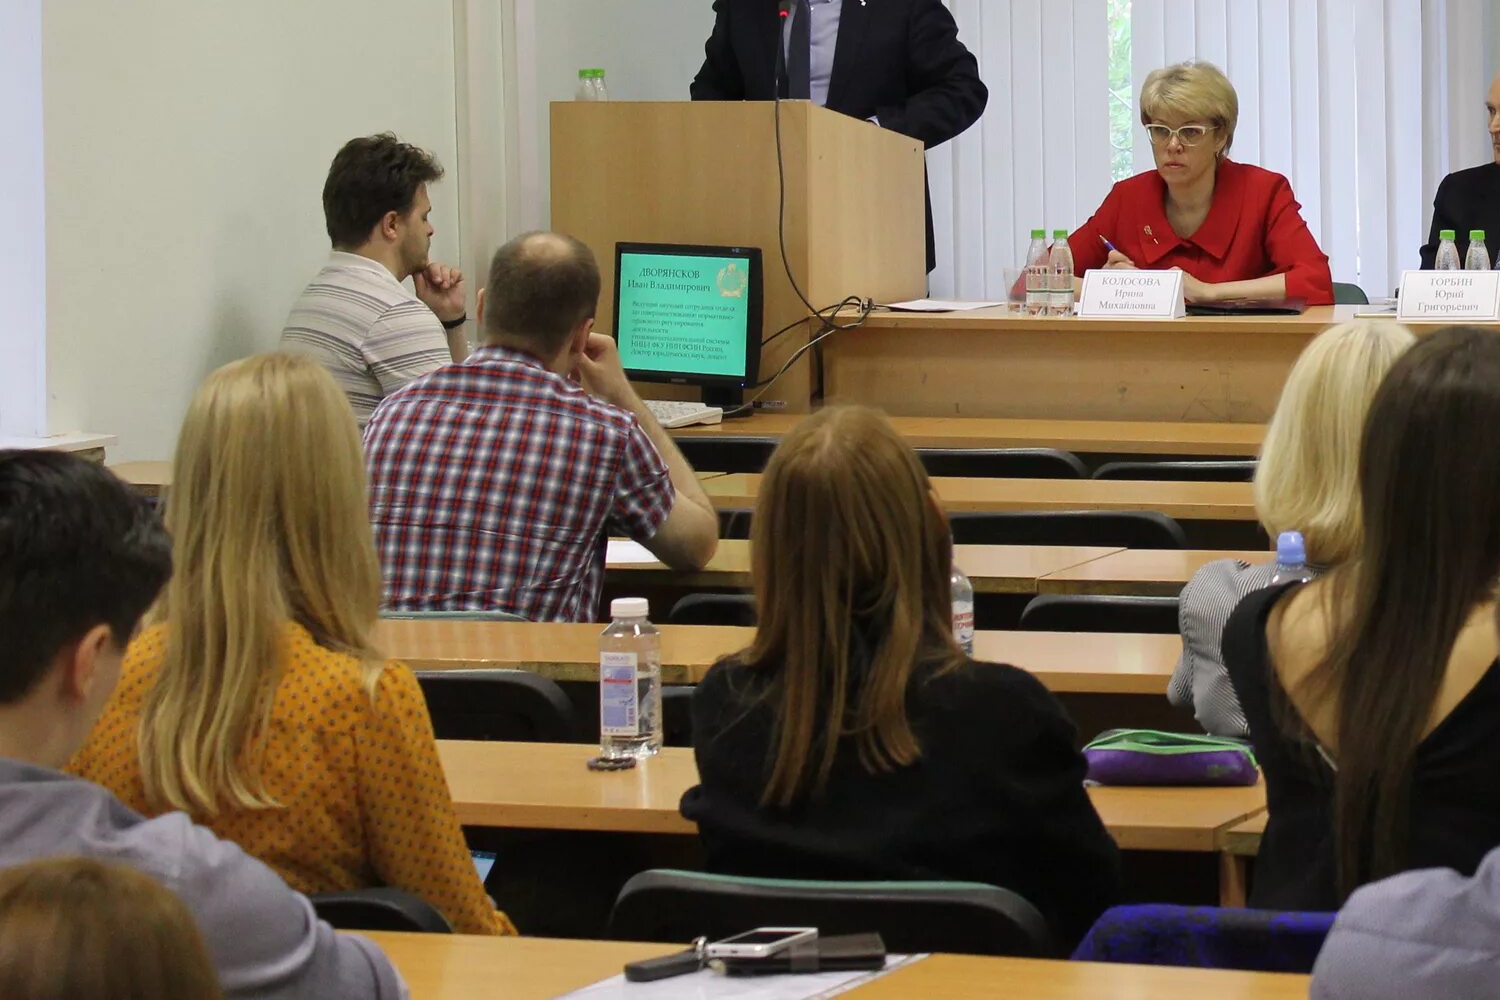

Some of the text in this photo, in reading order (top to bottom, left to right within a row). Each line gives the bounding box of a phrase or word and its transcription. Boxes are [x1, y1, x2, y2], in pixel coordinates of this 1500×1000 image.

[639, 267, 700, 279] ДВОРЯНСКОВ
[1102, 276, 1161, 287] КОЛОСОВА
[1115, 289, 1144, 299] Ирина
[1435, 289, 1464, 299] Юрий
[1099, 300, 1156, 310] Михайловна
[1417, 302, 1480, 313] Григорьевич
